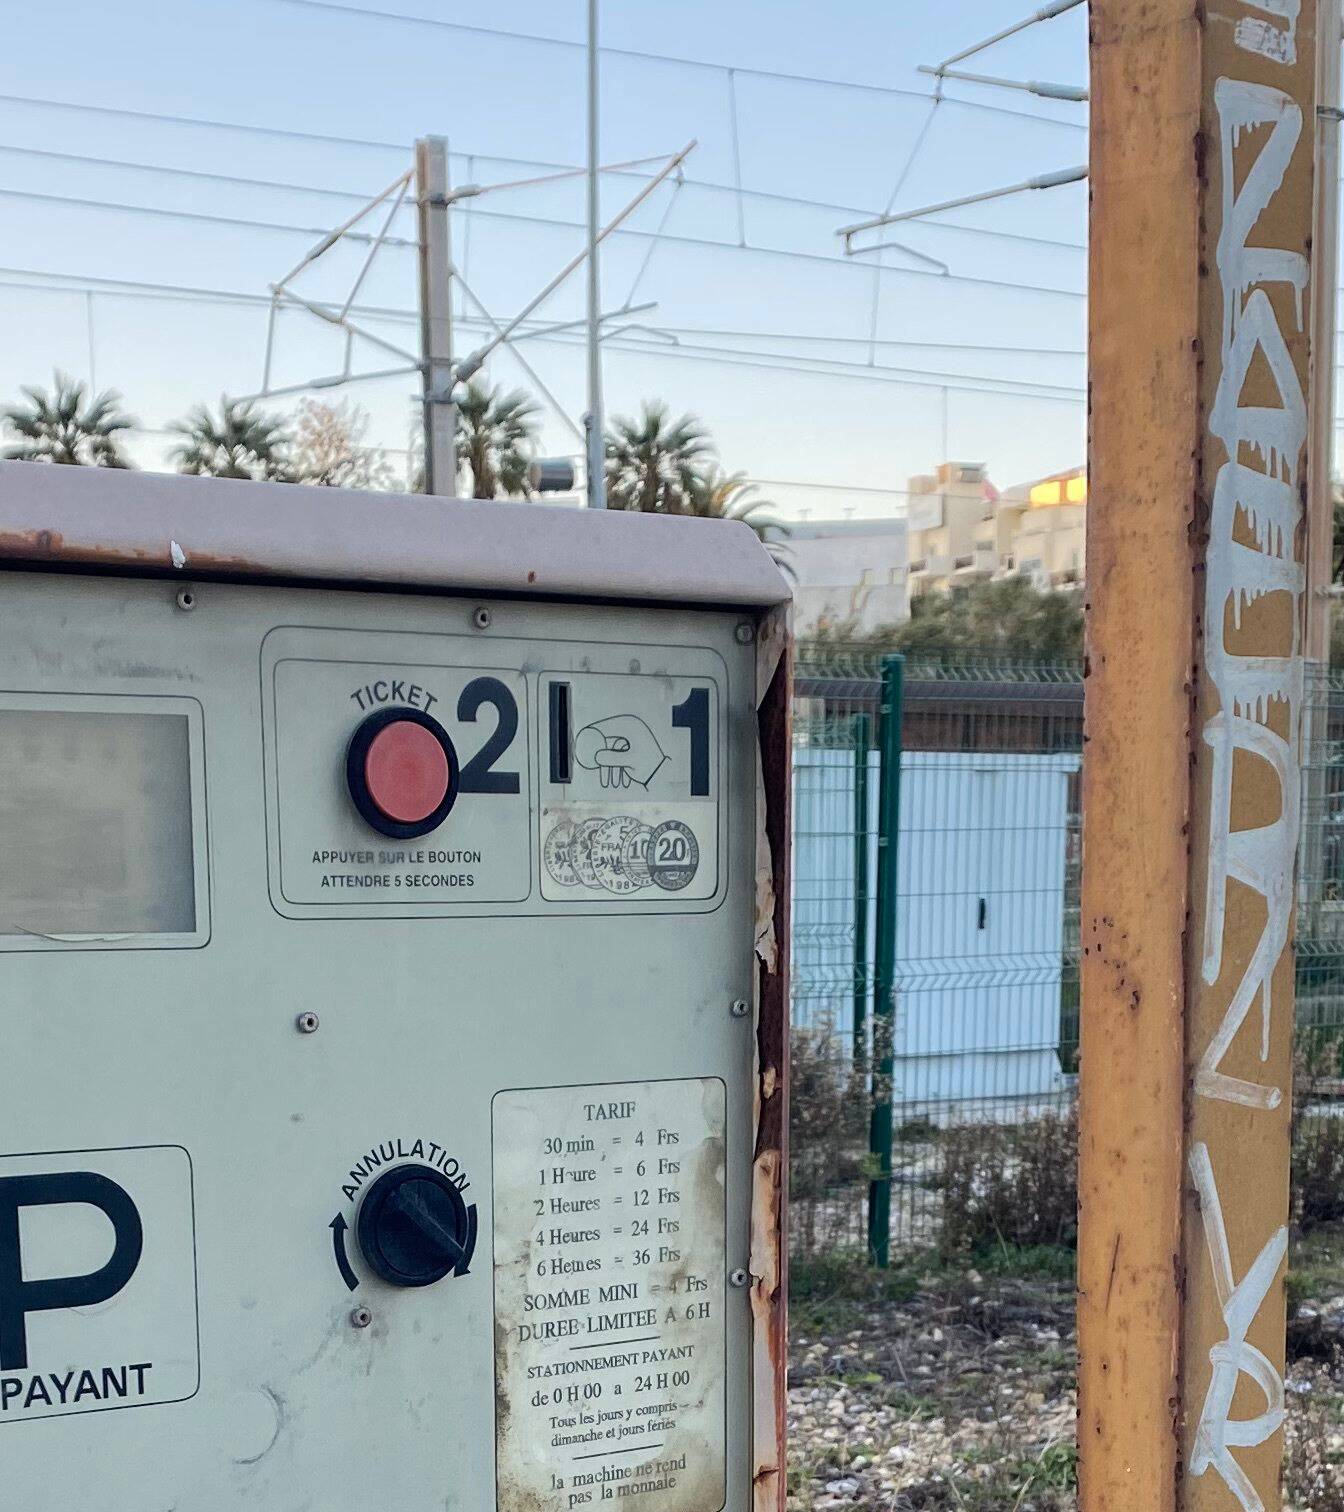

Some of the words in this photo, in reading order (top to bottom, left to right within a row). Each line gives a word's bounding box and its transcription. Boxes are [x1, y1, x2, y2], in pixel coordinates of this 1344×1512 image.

[351, 680, 438, 712] TICKET
[457, 676, 520, 794] 2
[671, 687, 710, 796] 1
[312, 850, 374, 865] APPUYER
[378, 850, 405, 865] SUR
[408, 850, 425, 864] LE
[428, 849, 481, 864] BOUTON
[659, 837, 686, 861] 20
[321, 874, 392, 888] ATTENDRE
[395, 874, 402, 888] 5
[405, 873, 474, 888] SECONDES
[584, 1102, 636, 1121] TARIF
[544, 1138, 562, 1154] 30
[567, 1135, 595, 1153] min
[635, 1131, 644, 1147] 4
[657, 1129, 680, 1145] Frs
[342, 1139, 470, 1202] ANNULATION
[539, 1169, 546, 1185] 1
[637, 1160, 646, 1176] 6
[658, 1158, 680, 1175] Frs
[534, 1200, 545, 1216] 2
[550, 1197, 601, 1214] Heures
[633, 1190, 650, 1206] 12
[658, 1188, 680, 1204] Frs
[536, 1231, 545, 1246] 4
[549, 1228, 601, 1246] Heures
[631, 1220, 649, 1236] 24
[658, 1217, 680, 1234] Frs
[537, 1260, 546, 1276] 6
[632, 1249, 651, 1266] 36
[659, 1247, 681, 1263] Frs
[524, 1288, 590, 1312] SOMME
[599, 1282, 639, 1303] MINI
[684, 1276, 708, 1293] Frs
[518, 1318, 579, 1343] DUREE
[587, 1309, 656, 1333] LIMITEE
[664, 1306, 676, 1323] A
[686, 1304, 695, 1320] 6
[698, 1301, 711, 1319] H
[527, 1353, 639, 1379] STATIONNEMENT
[642, 1345, 694, 1364] PAYANT
[0, 1362, 153, 1410] PAYANT
[531, 1390, 549, 1407] de
[553, 1388, 562, 1404] 0
[567, 1385, 579, 1402] H
[584, 1383, 602, 1399] 00
[635, 1375, 652, 1392] 24
[656, 1373, 668, 1389] H
[672, 1370, 690, 1386] 00
[549, 1416, 576, 1429] Tous
[579, 1412, 594, 1425] les
[596, 1409, 624, 1427] jours
[626, 1409, 634, 1421] y
[636, 1399, 678, 1417] compris
[551, 1430, 603, 1446] dimanche
[606, 1426, 616, 1439] et
[618, 1423, 645, 1440] jours
[551, 1473, 564, 1491] la
[573, 1465, 631, 1487] machine
[636, 1462, 652, 1477] ne
[656, 1454, 686, 1473] rend
[568, 1490, 592, 1509] pas
[601, 1484, 613, 1500] la
[618, 1475, 677, 1498] monnaie
